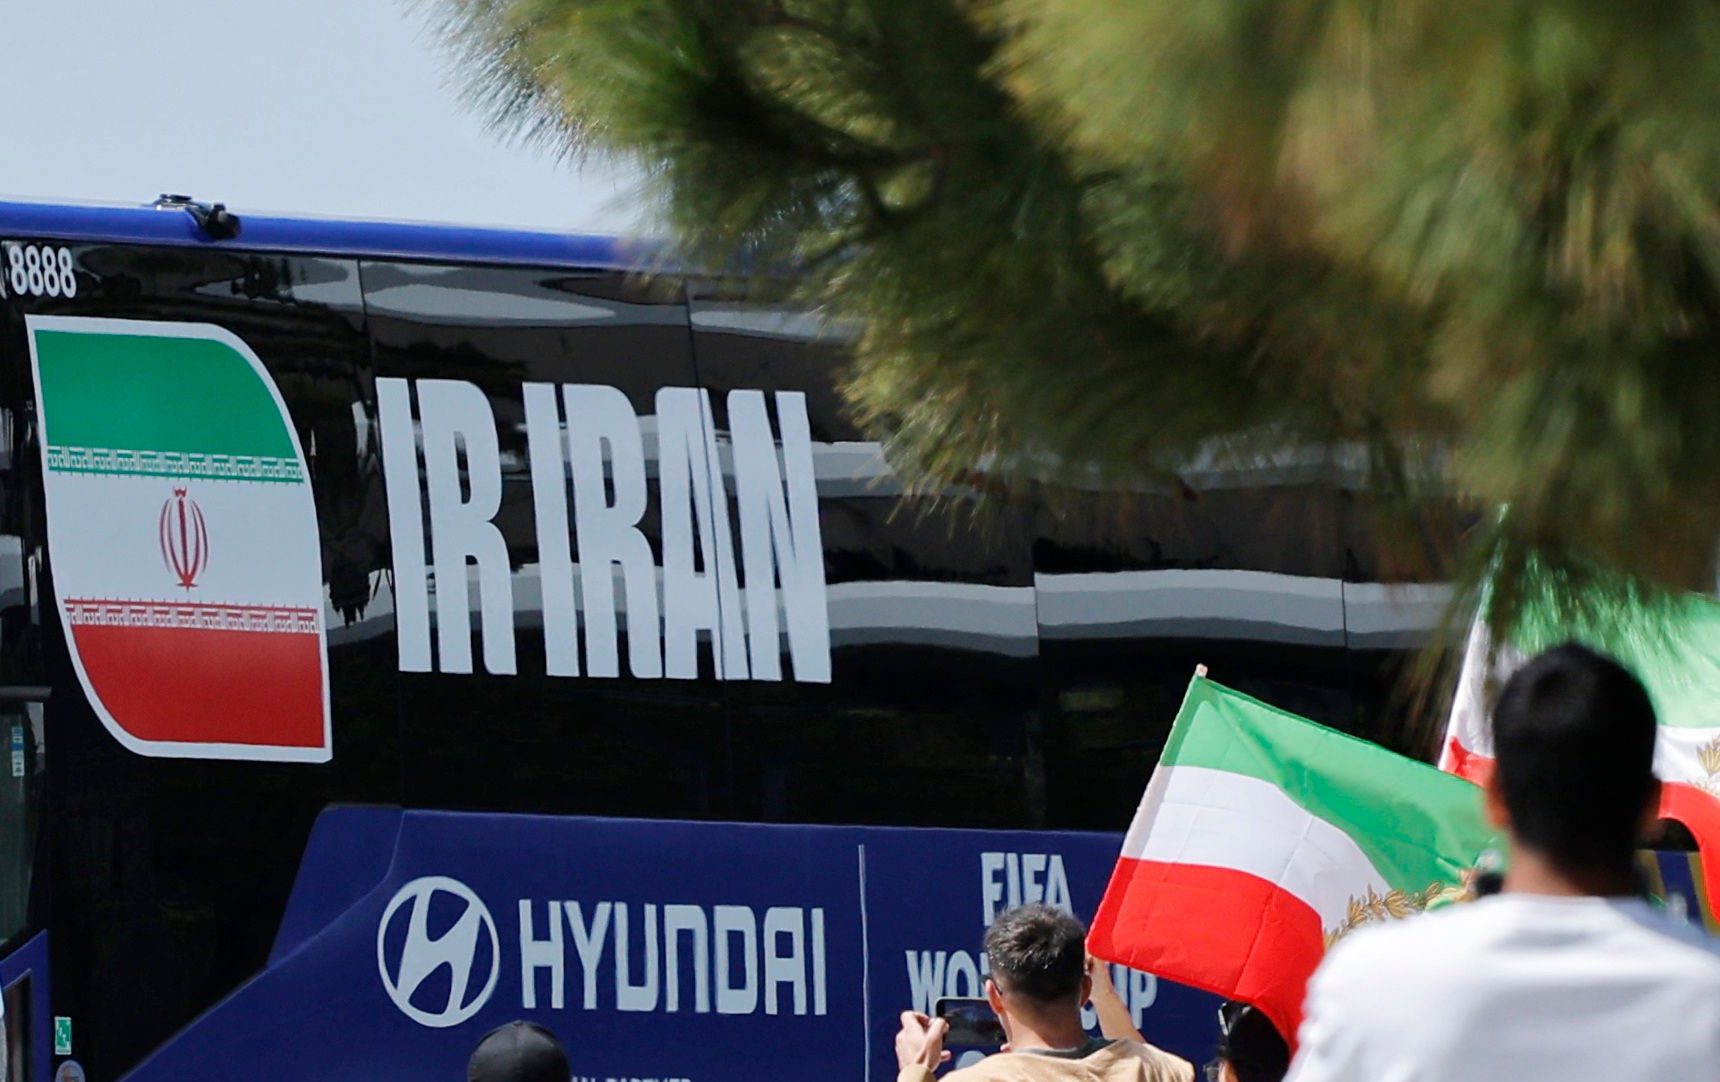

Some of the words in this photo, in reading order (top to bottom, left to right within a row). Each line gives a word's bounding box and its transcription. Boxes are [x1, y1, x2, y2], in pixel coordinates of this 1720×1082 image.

[9, 245, 77, 299] 8888
[376, 377, 518, 675] IR
[521, 381, 832, 684] IRAN
[980, 852, 1075, 927] FIFA
[518, 899, 827, 1016] HYUNDAI
